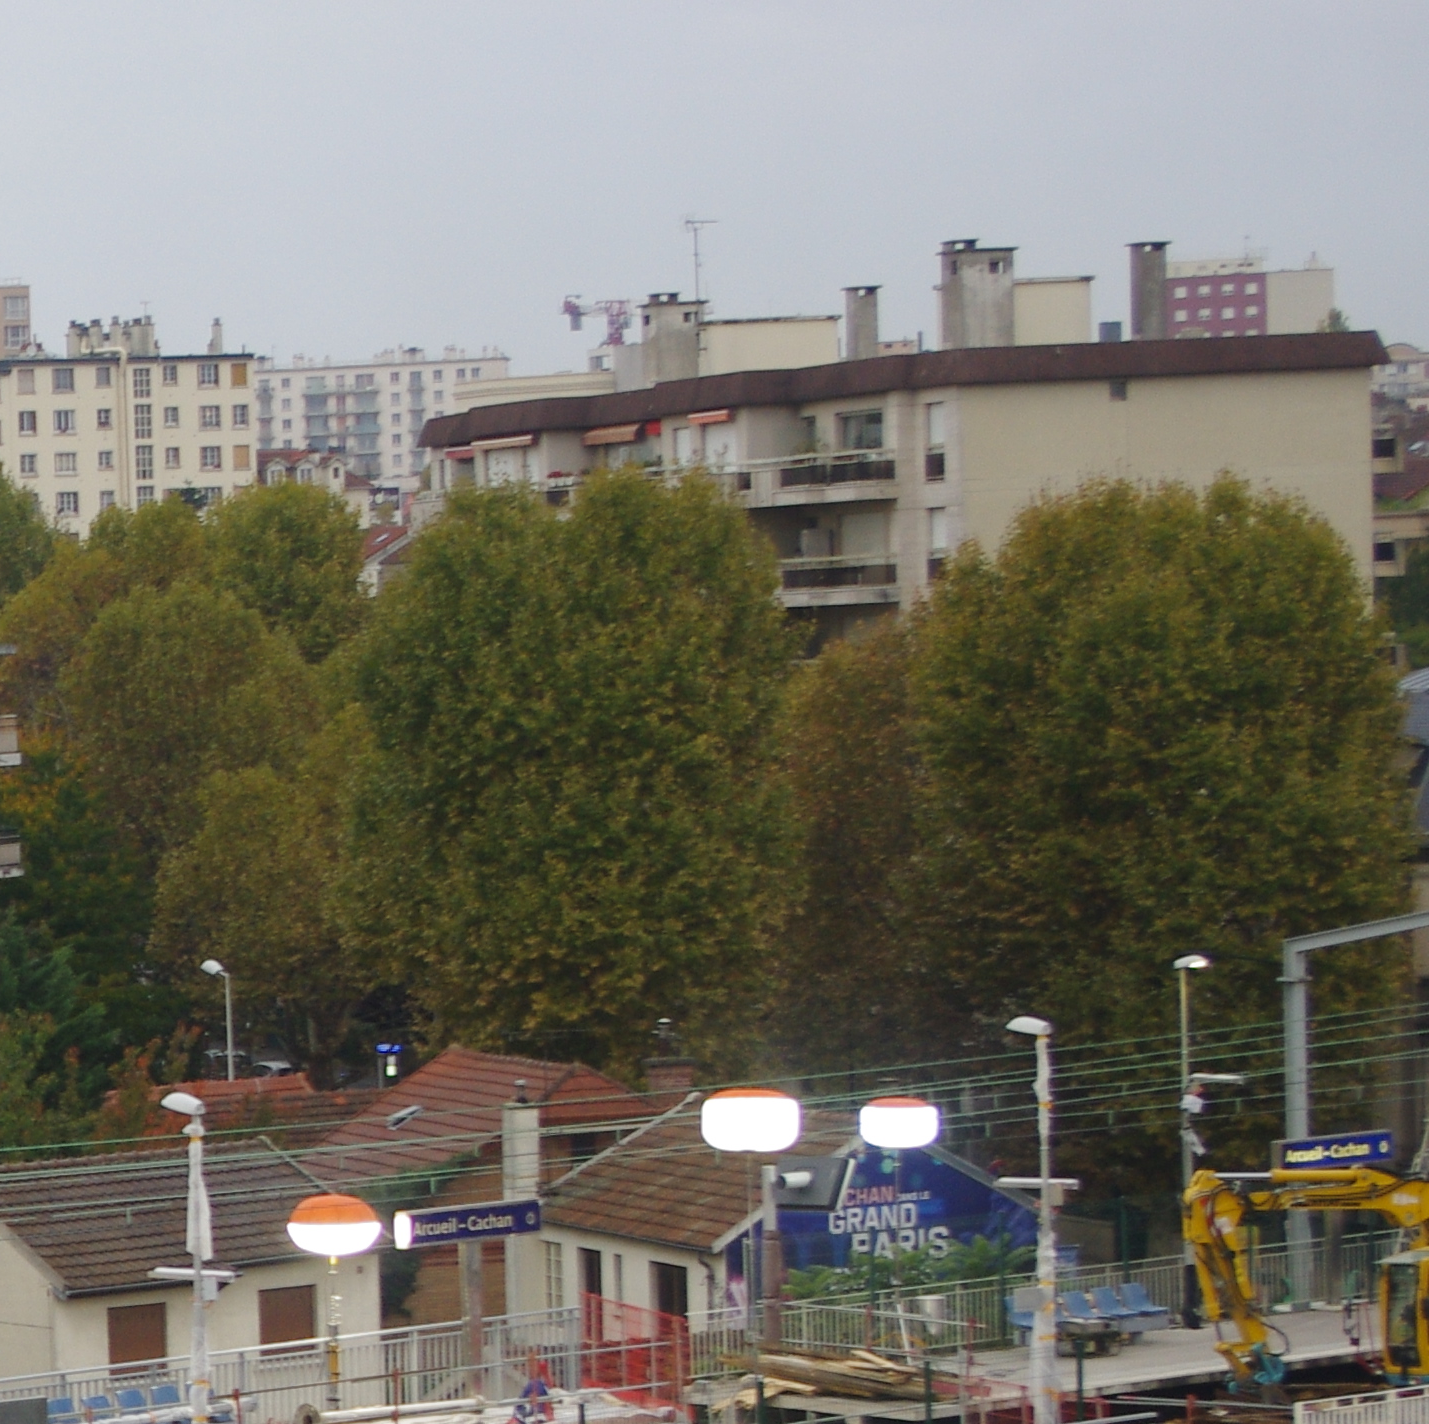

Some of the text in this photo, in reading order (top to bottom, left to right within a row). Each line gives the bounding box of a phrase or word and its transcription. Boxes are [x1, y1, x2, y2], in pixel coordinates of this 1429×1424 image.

[844, 1186, 894, 1207] CHAN
[828, 1203, 917, 1234] GRAND
[852, 1226, 950, 1259] PARIS
